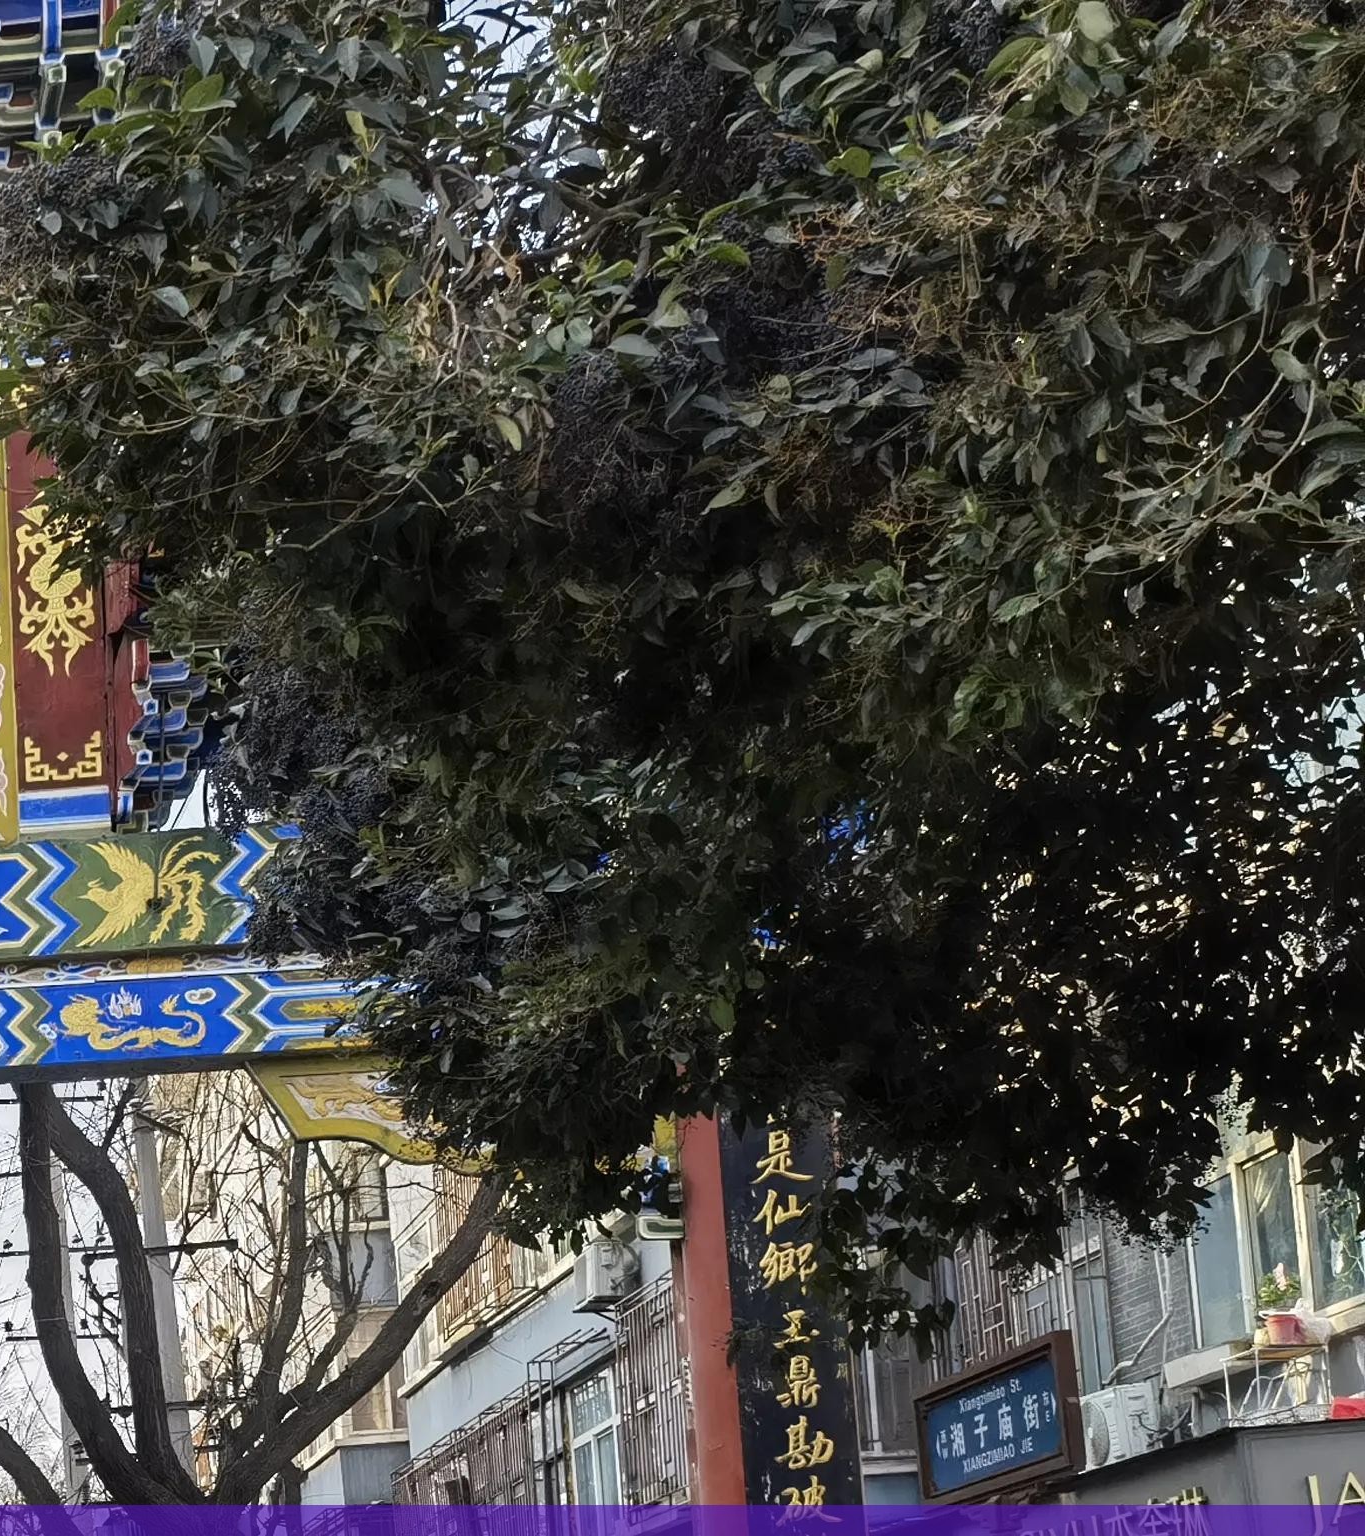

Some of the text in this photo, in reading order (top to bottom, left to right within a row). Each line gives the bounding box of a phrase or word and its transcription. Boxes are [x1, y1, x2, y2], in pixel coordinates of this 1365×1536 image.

[950, 1394, 1040, 1458] 湘子庙街
[962, 1436, 1034, 1473] XIANGZIMIAO JIE
